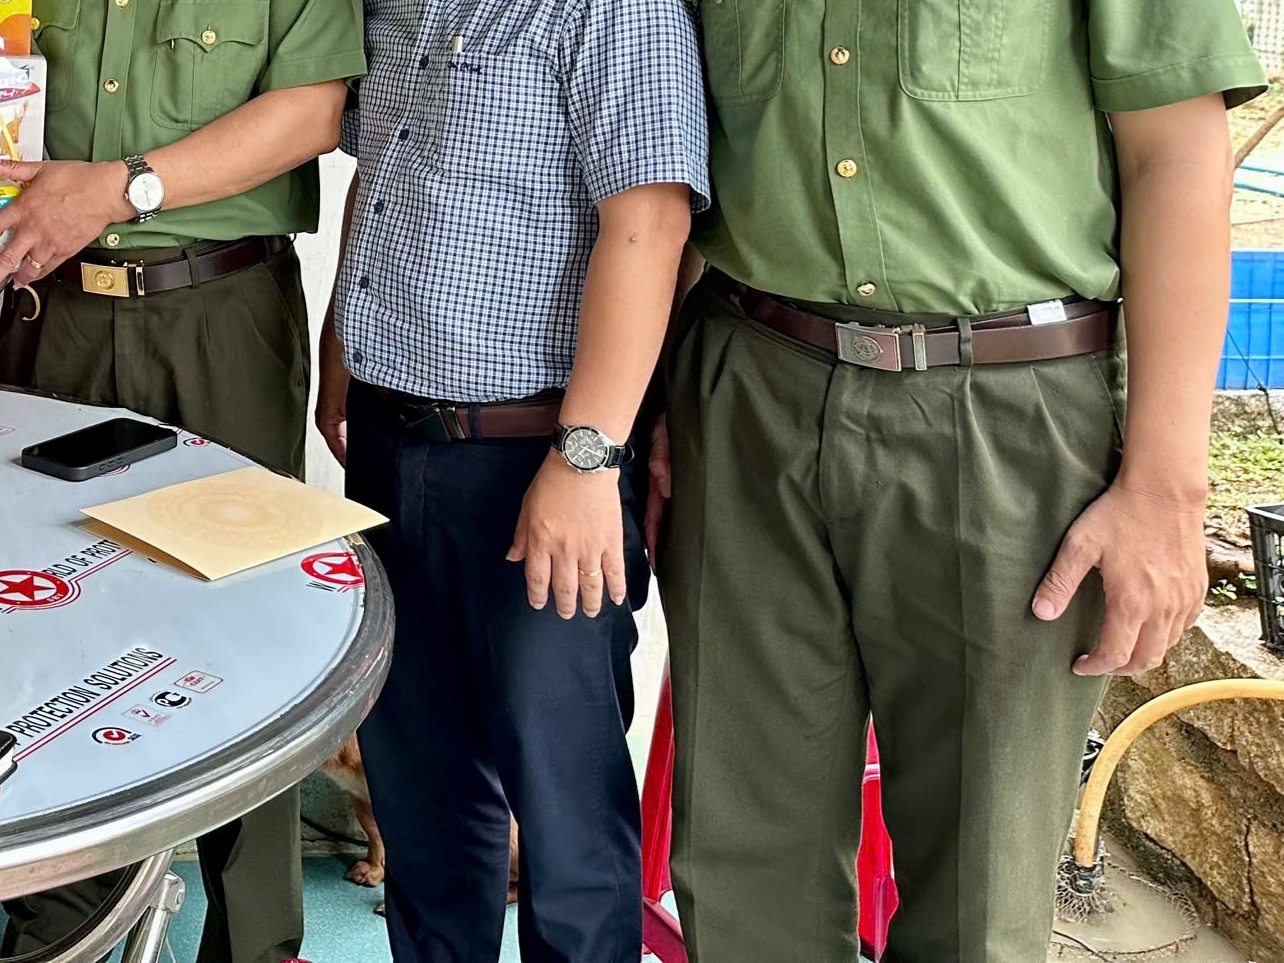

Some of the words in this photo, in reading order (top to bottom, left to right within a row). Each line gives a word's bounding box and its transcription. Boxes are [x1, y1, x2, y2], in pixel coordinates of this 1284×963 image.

[66, 554, 93, 568] OF
[5, 685, 101, 738] PROTECTION
[83, 646, 164, 690] SOLUTIONS
